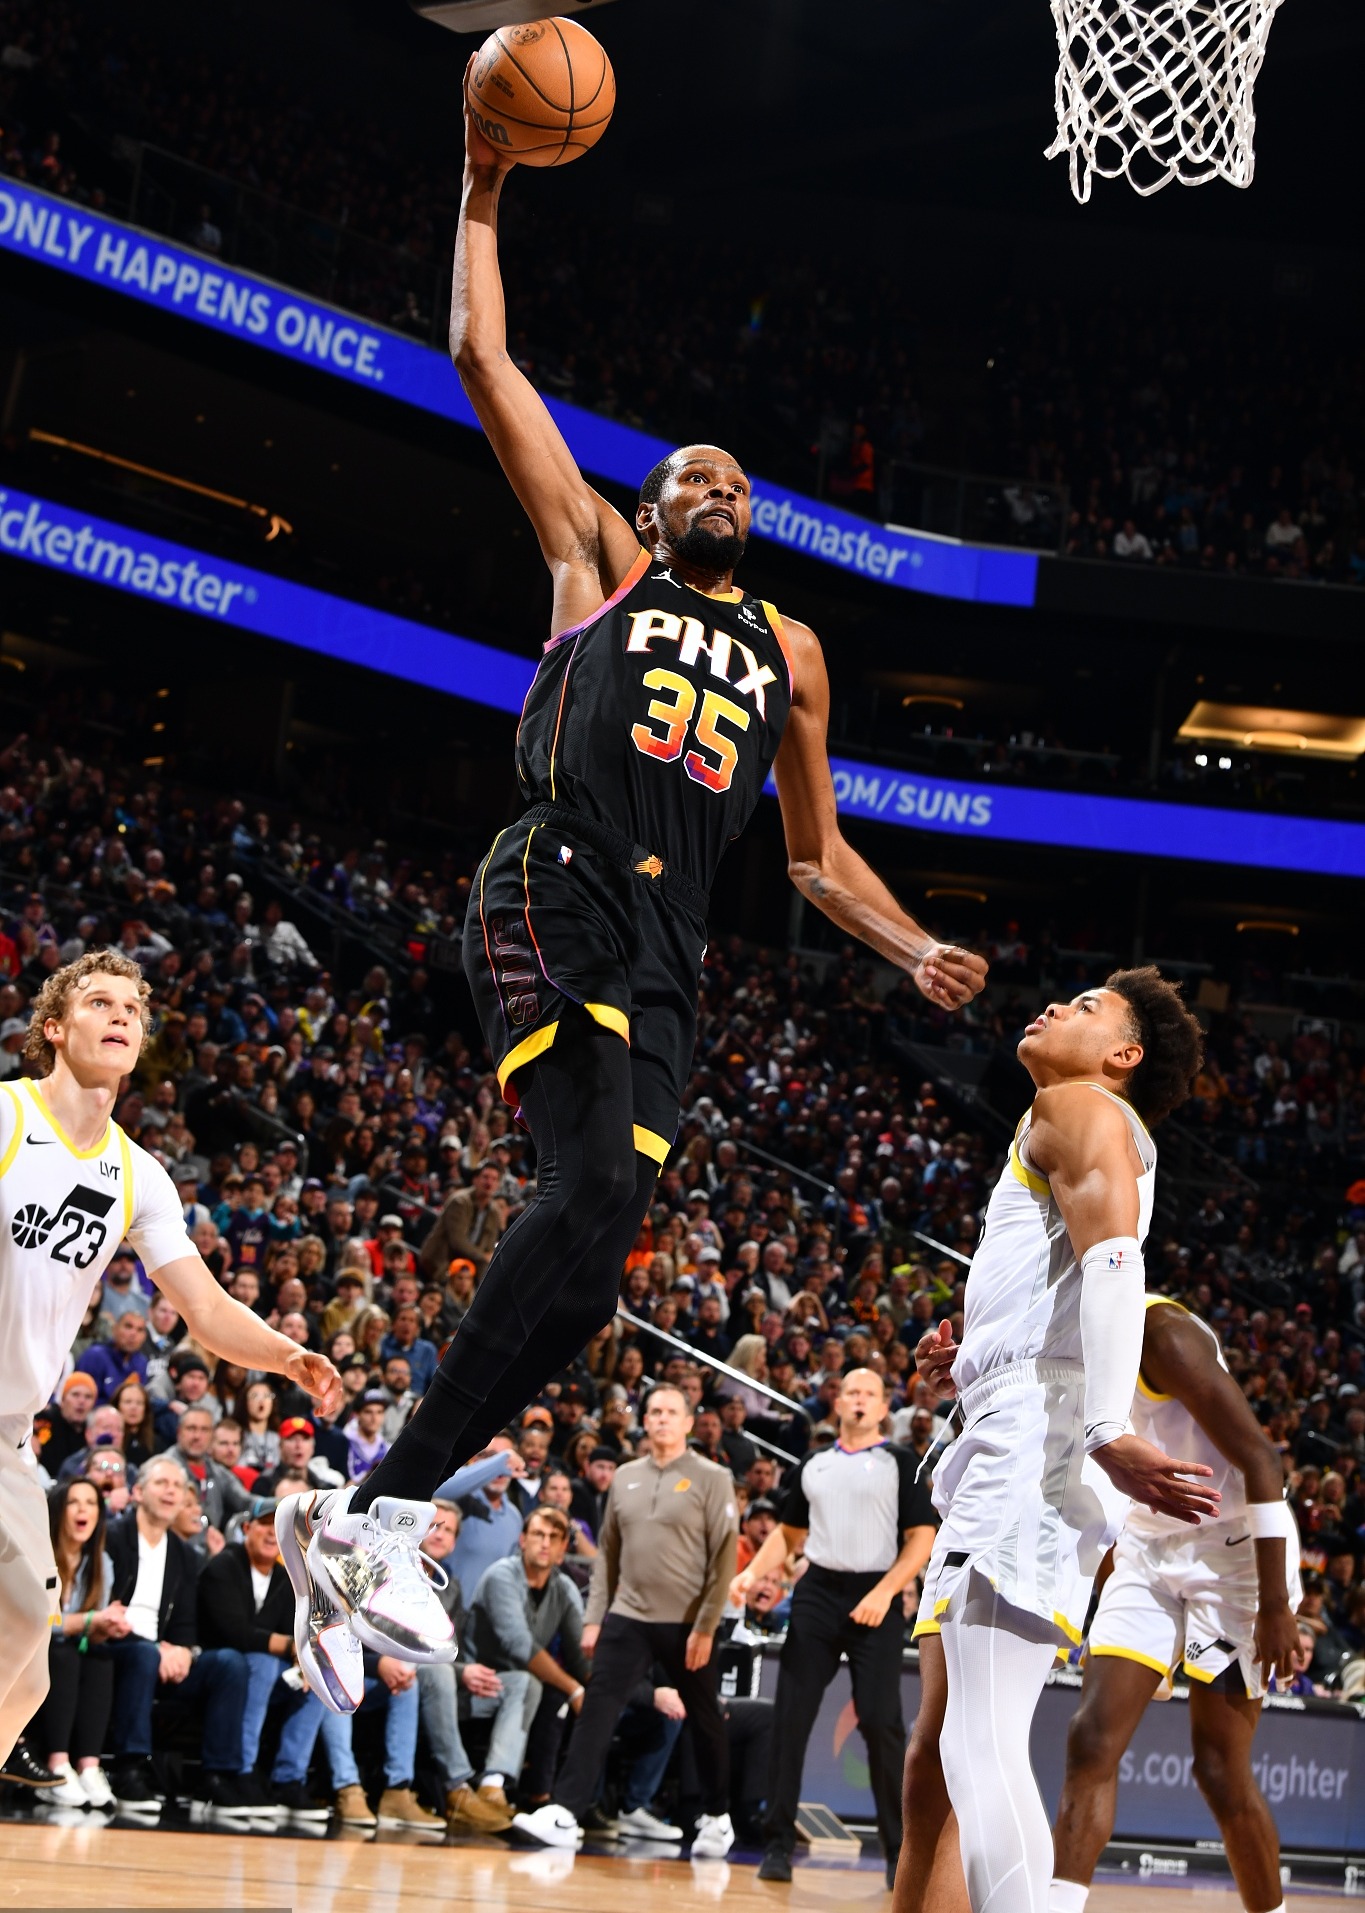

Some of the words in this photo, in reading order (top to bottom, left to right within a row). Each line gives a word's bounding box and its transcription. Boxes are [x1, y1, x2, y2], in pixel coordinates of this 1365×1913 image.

[94, 233, 271, 335] HAPPENS
[275, 306, 384, 381] ONCE.
[624, 609, 778, 723] PHX
[737, 613, 768, 635] PayPal
[631, 667, 750, 793] 35
[832, 770, 993, 827] OM/SUNS
[491, 917, 541, 1025] SUNS
[50, 1211, 107, 1269] 23
